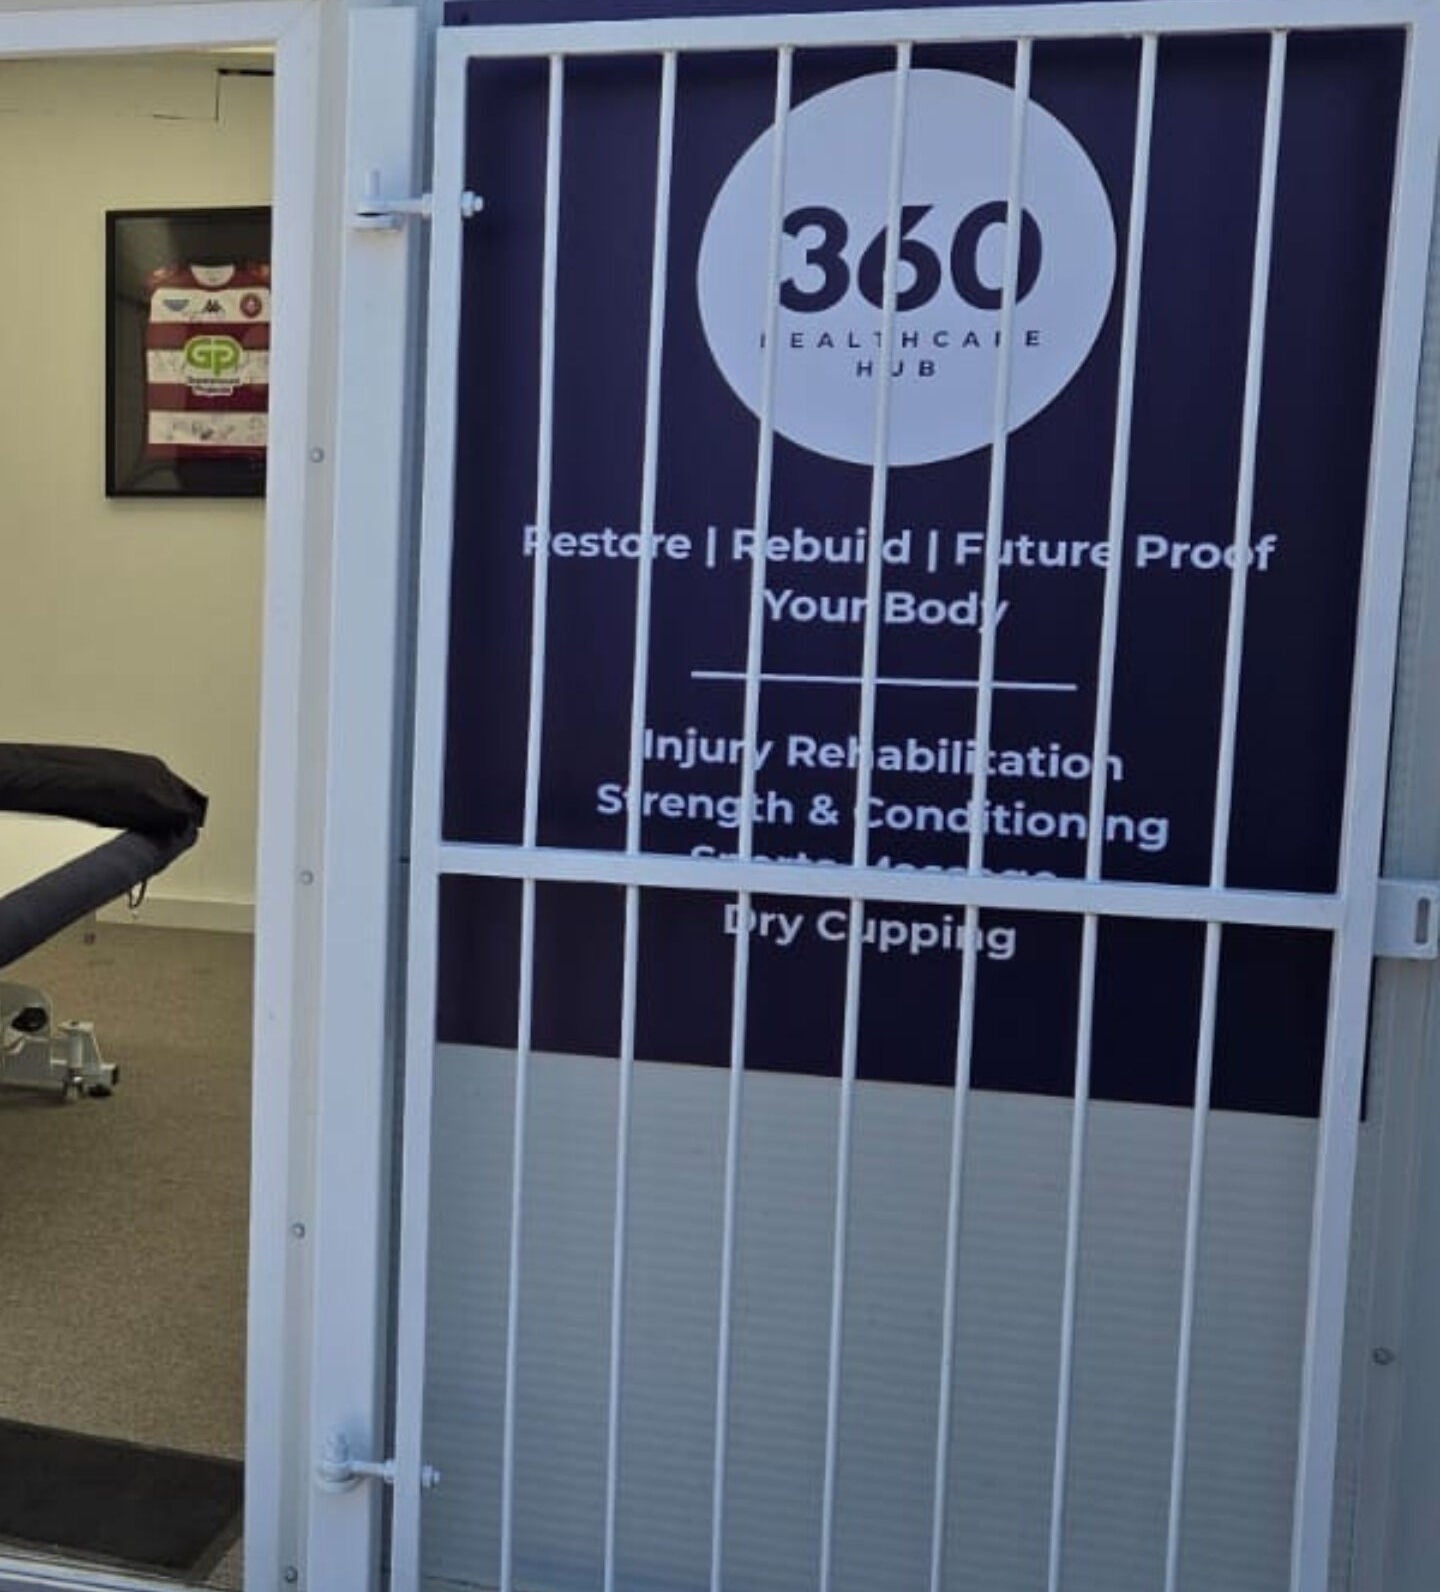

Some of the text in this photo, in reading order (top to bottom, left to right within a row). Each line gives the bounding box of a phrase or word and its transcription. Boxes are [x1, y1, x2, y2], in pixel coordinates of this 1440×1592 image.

[779, 200, 1043, 313] 360
[732, 526, 912, 565] Rebuid
[1136, 534, 1278, 571] Proof
[762, 588, 871, 623] Your
[596, 783, 1169, 852] Srength & Conditionng
